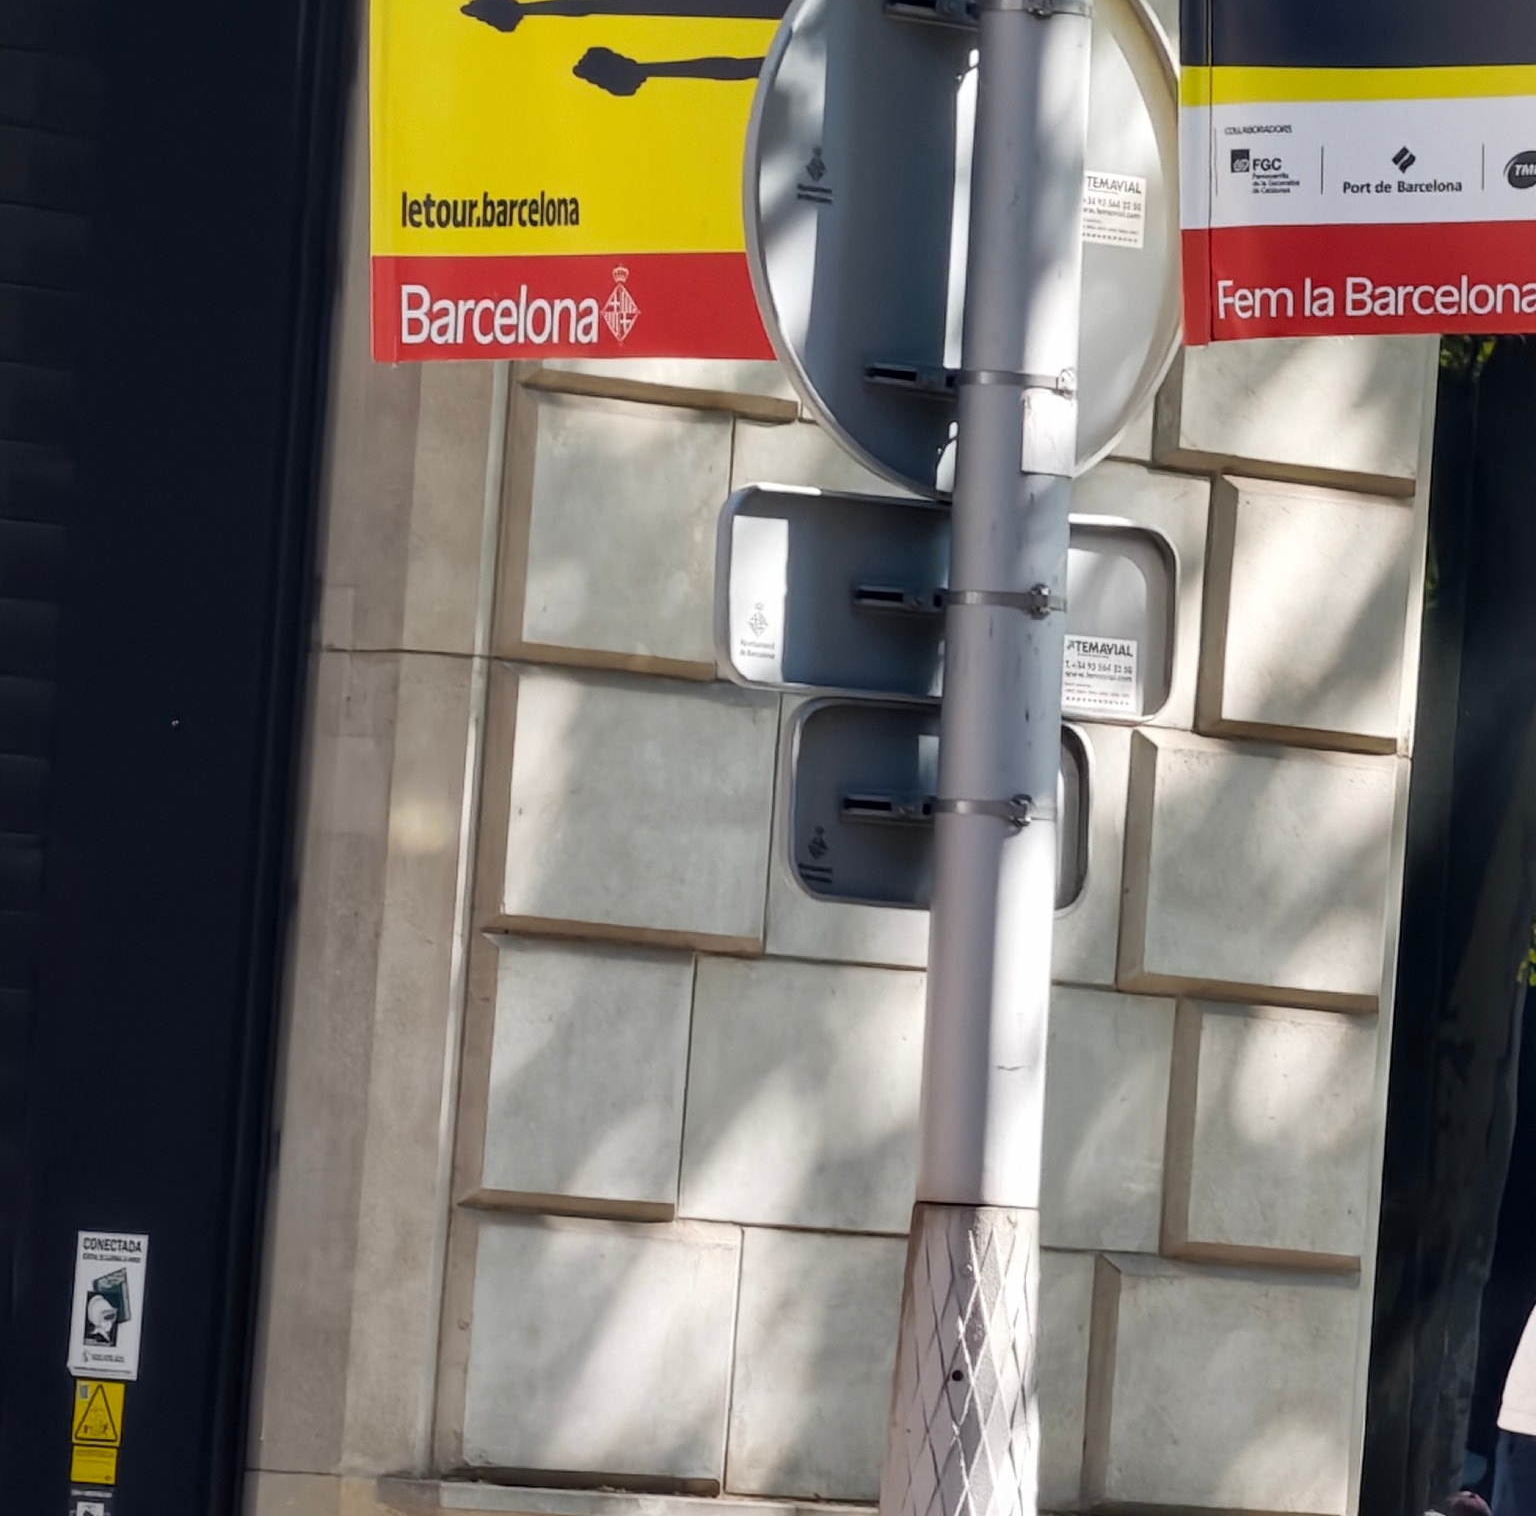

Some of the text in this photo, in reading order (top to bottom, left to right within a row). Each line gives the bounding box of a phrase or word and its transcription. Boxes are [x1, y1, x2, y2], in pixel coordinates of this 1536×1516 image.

[1252, 157, 1282, 171] FGC
[1087, 175, 1141, 194] TEMAVIAL
[1343, 178, 1463, 194] Port de Barcelona
[401, 191, 579, 228] letour.barcelona
[1217, 279, 1293, 319] Fem
[1304, 278, 1334, 317] la
[401, 284, 599, 345] Barcelona
[1075, 640, 1133, 658] TEMAVIAL
